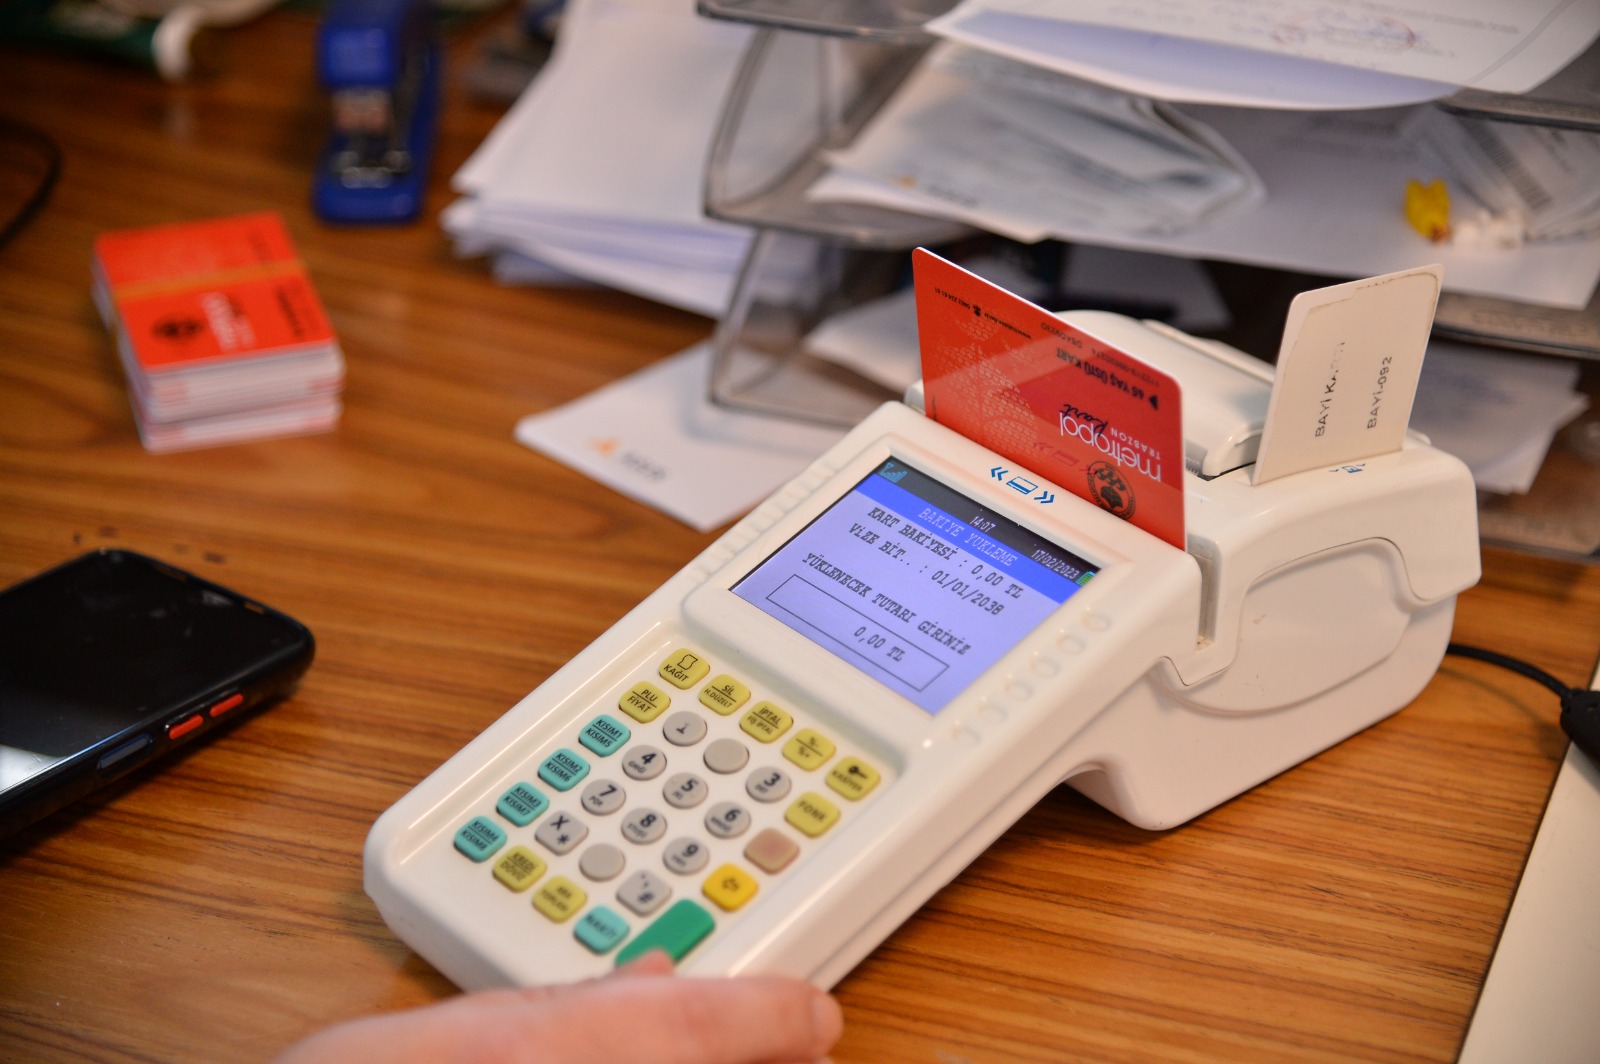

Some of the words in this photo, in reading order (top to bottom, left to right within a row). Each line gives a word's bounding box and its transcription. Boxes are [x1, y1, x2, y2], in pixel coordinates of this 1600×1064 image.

[1057, 347, 1082, 370] KART
[1083, 361, 1108, 385] ÜSTÜ
[1110, 373, 1130, 394] YAŞ
[1059, 411, 1161, 482] metropol
[1111, 427, 1161, 461] TRABZON
[969, 515, 996, 533] 14:07
[867, 506, 900, 528] KART
[898, 524, 959, 561] BAKİYESİ
[970, 564, 1005, 587] 0,00
[1004, 583, 1024, 599] TL
[1030, 548, 1080, 580] 17/02/2023
[931, 569, 1005, 616] 01/01/2038
[802, 552, 873, 598] YÜKLENECEK
[871, 593, 917, 623] TUTARI
[917, 620, 972, 655] GİRİNİZ
[853, 625, 887, 649] 0,00
[886, 646, 906, 662] TL
[663, 663, 690, 682] KAĞIT
[640, 689, 659, 702] PLU
[703, 688, 733, 709] H.DÜZELT
[721, 683, 735, 696] SİL
[626, 694, 652, 713] FİYAT
[758, 705, 782, 725] İPTAL
[585, 727, 613, 748] KISIM5
[595, 718, 623, 739] KISIM1
[555, 752, 583, 773] KISIM2
[641, 753, 657, 765] 4
[544, 761, 572, 782] KISIM6
[764, 772, 781, 787] 3
[599, 784, 618, 797] 7
[681, 778, 699, 793] 5
[503, 795, 531, 816] KISIM7
[514, 786, 542, 808] KISIM3
[640, 813, 658, 828] 8
[724, 807, 742, 822] 6
[471, 820, 499, 842] KISIM4
[681, 843, 699, 858] 9
